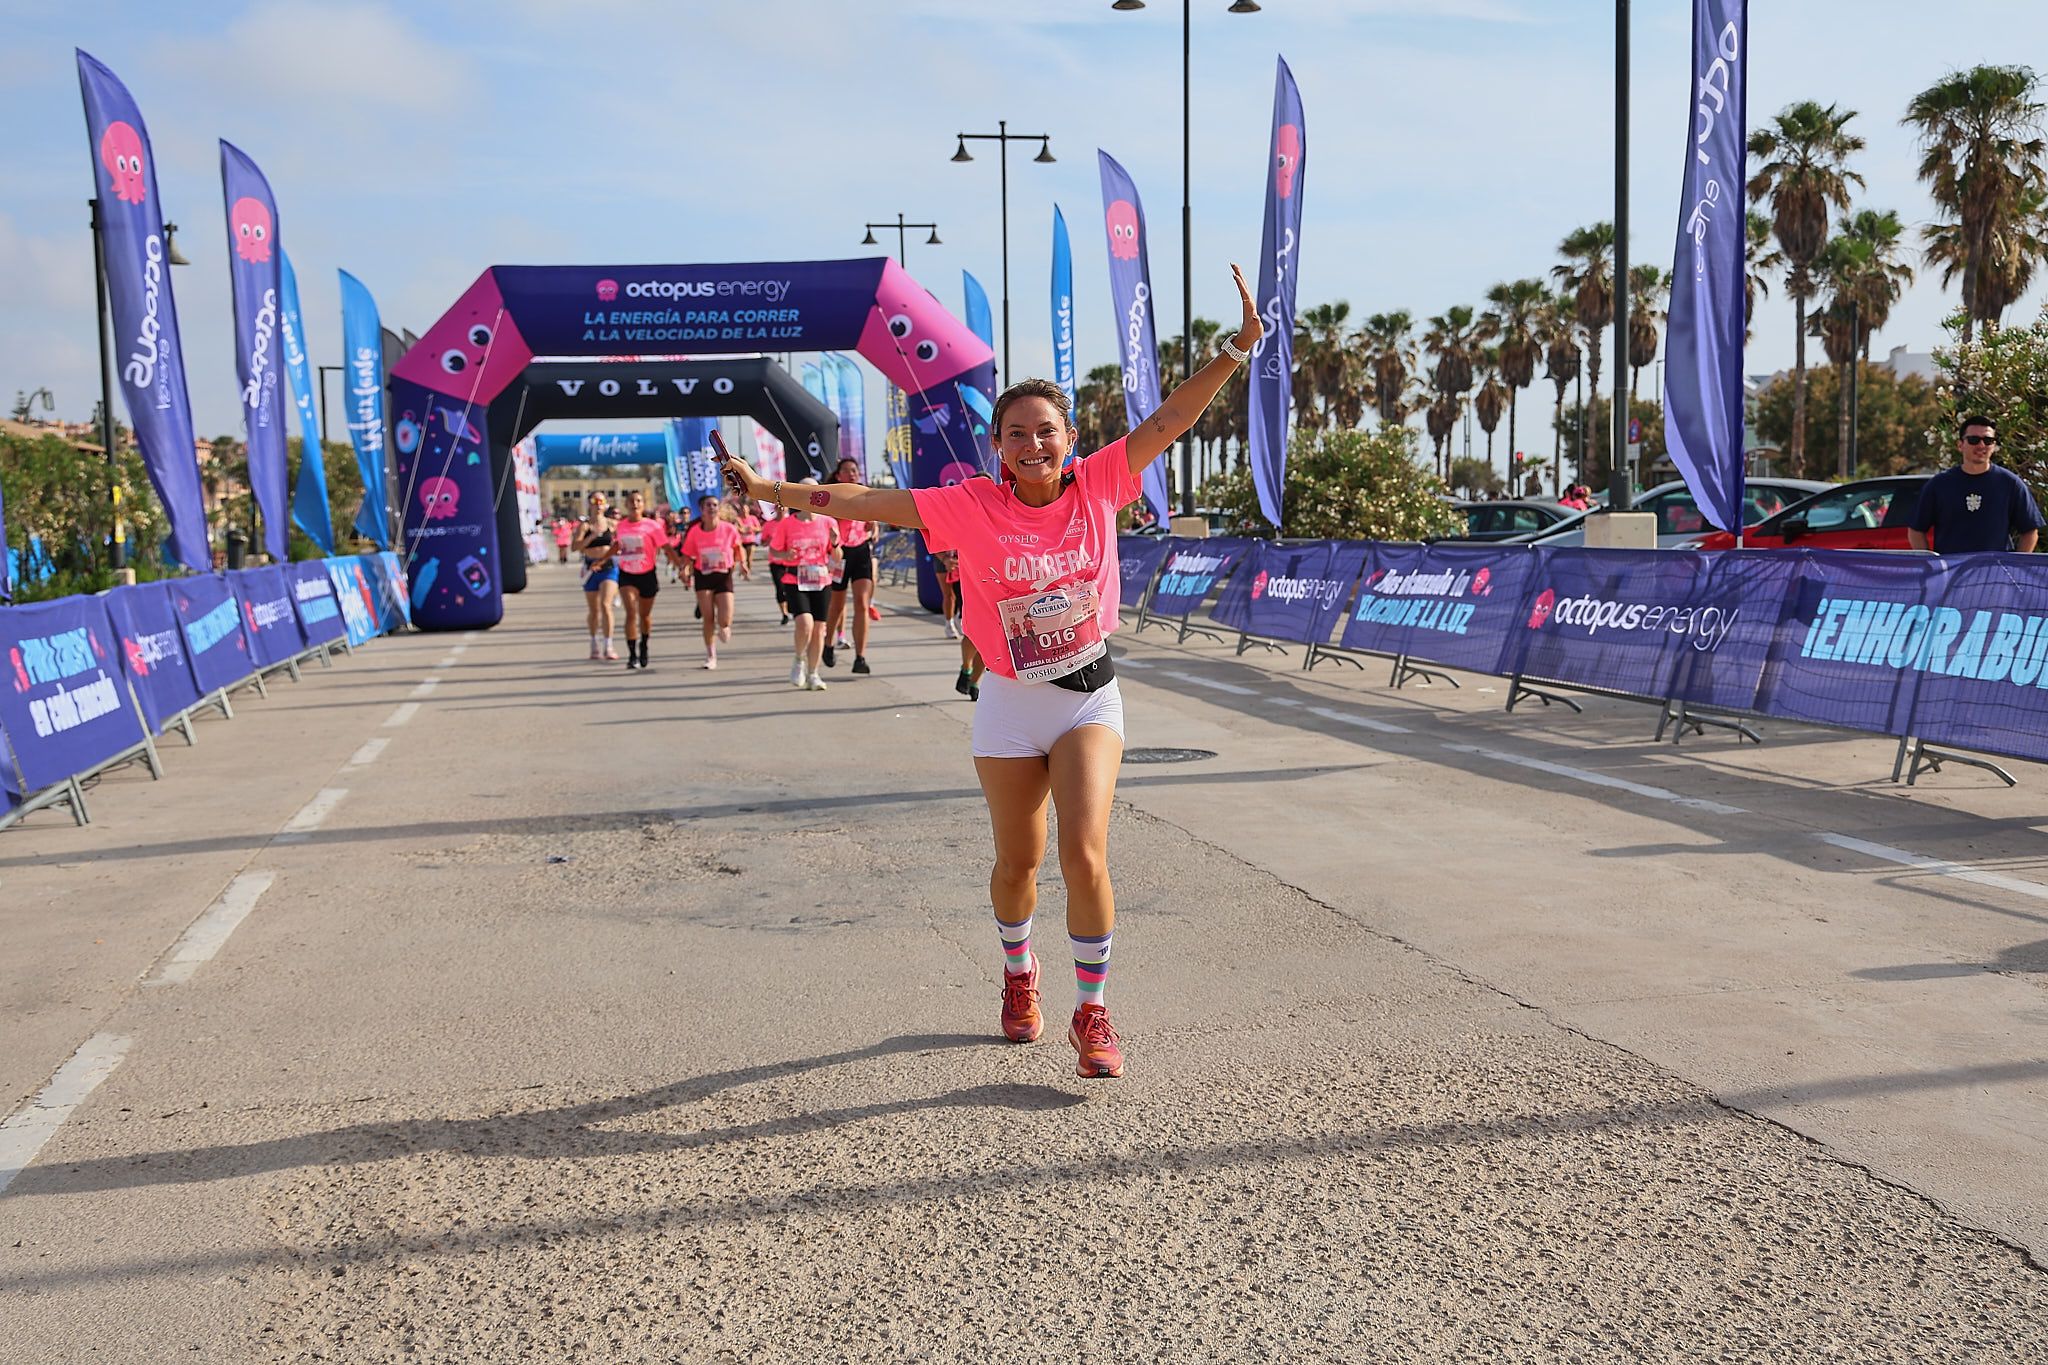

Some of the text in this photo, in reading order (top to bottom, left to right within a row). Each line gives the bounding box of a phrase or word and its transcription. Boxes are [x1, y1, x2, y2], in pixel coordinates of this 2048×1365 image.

[625, 280, 791, 302] octopus energy
[584, 308, 799, 325] LA ENERGÍA PARA CORRER
[583, 326, 803, 341] A LA VELOCIDAD DE LA LUZ
[556, 377, 734, 397] VOLVO
[998, 534, 1039, 544] OYSHO
[1005, 546, 1094, 581] CARRERA
[1268, 574, 1344, 611] octopus energy
[1032, 602, 1069, 615] ASTURIANA
[1417, 600, 1444, 629] LA
[1437, 601, 1475, 635] LUZ
[1554, 594, 1739, 651] octopus energy
[1038, 627, 1076, 648] 016
[1800, 597, 2048, 690] ¡ENHORABU
[1026, 667, 1057, 680] OYSHO
